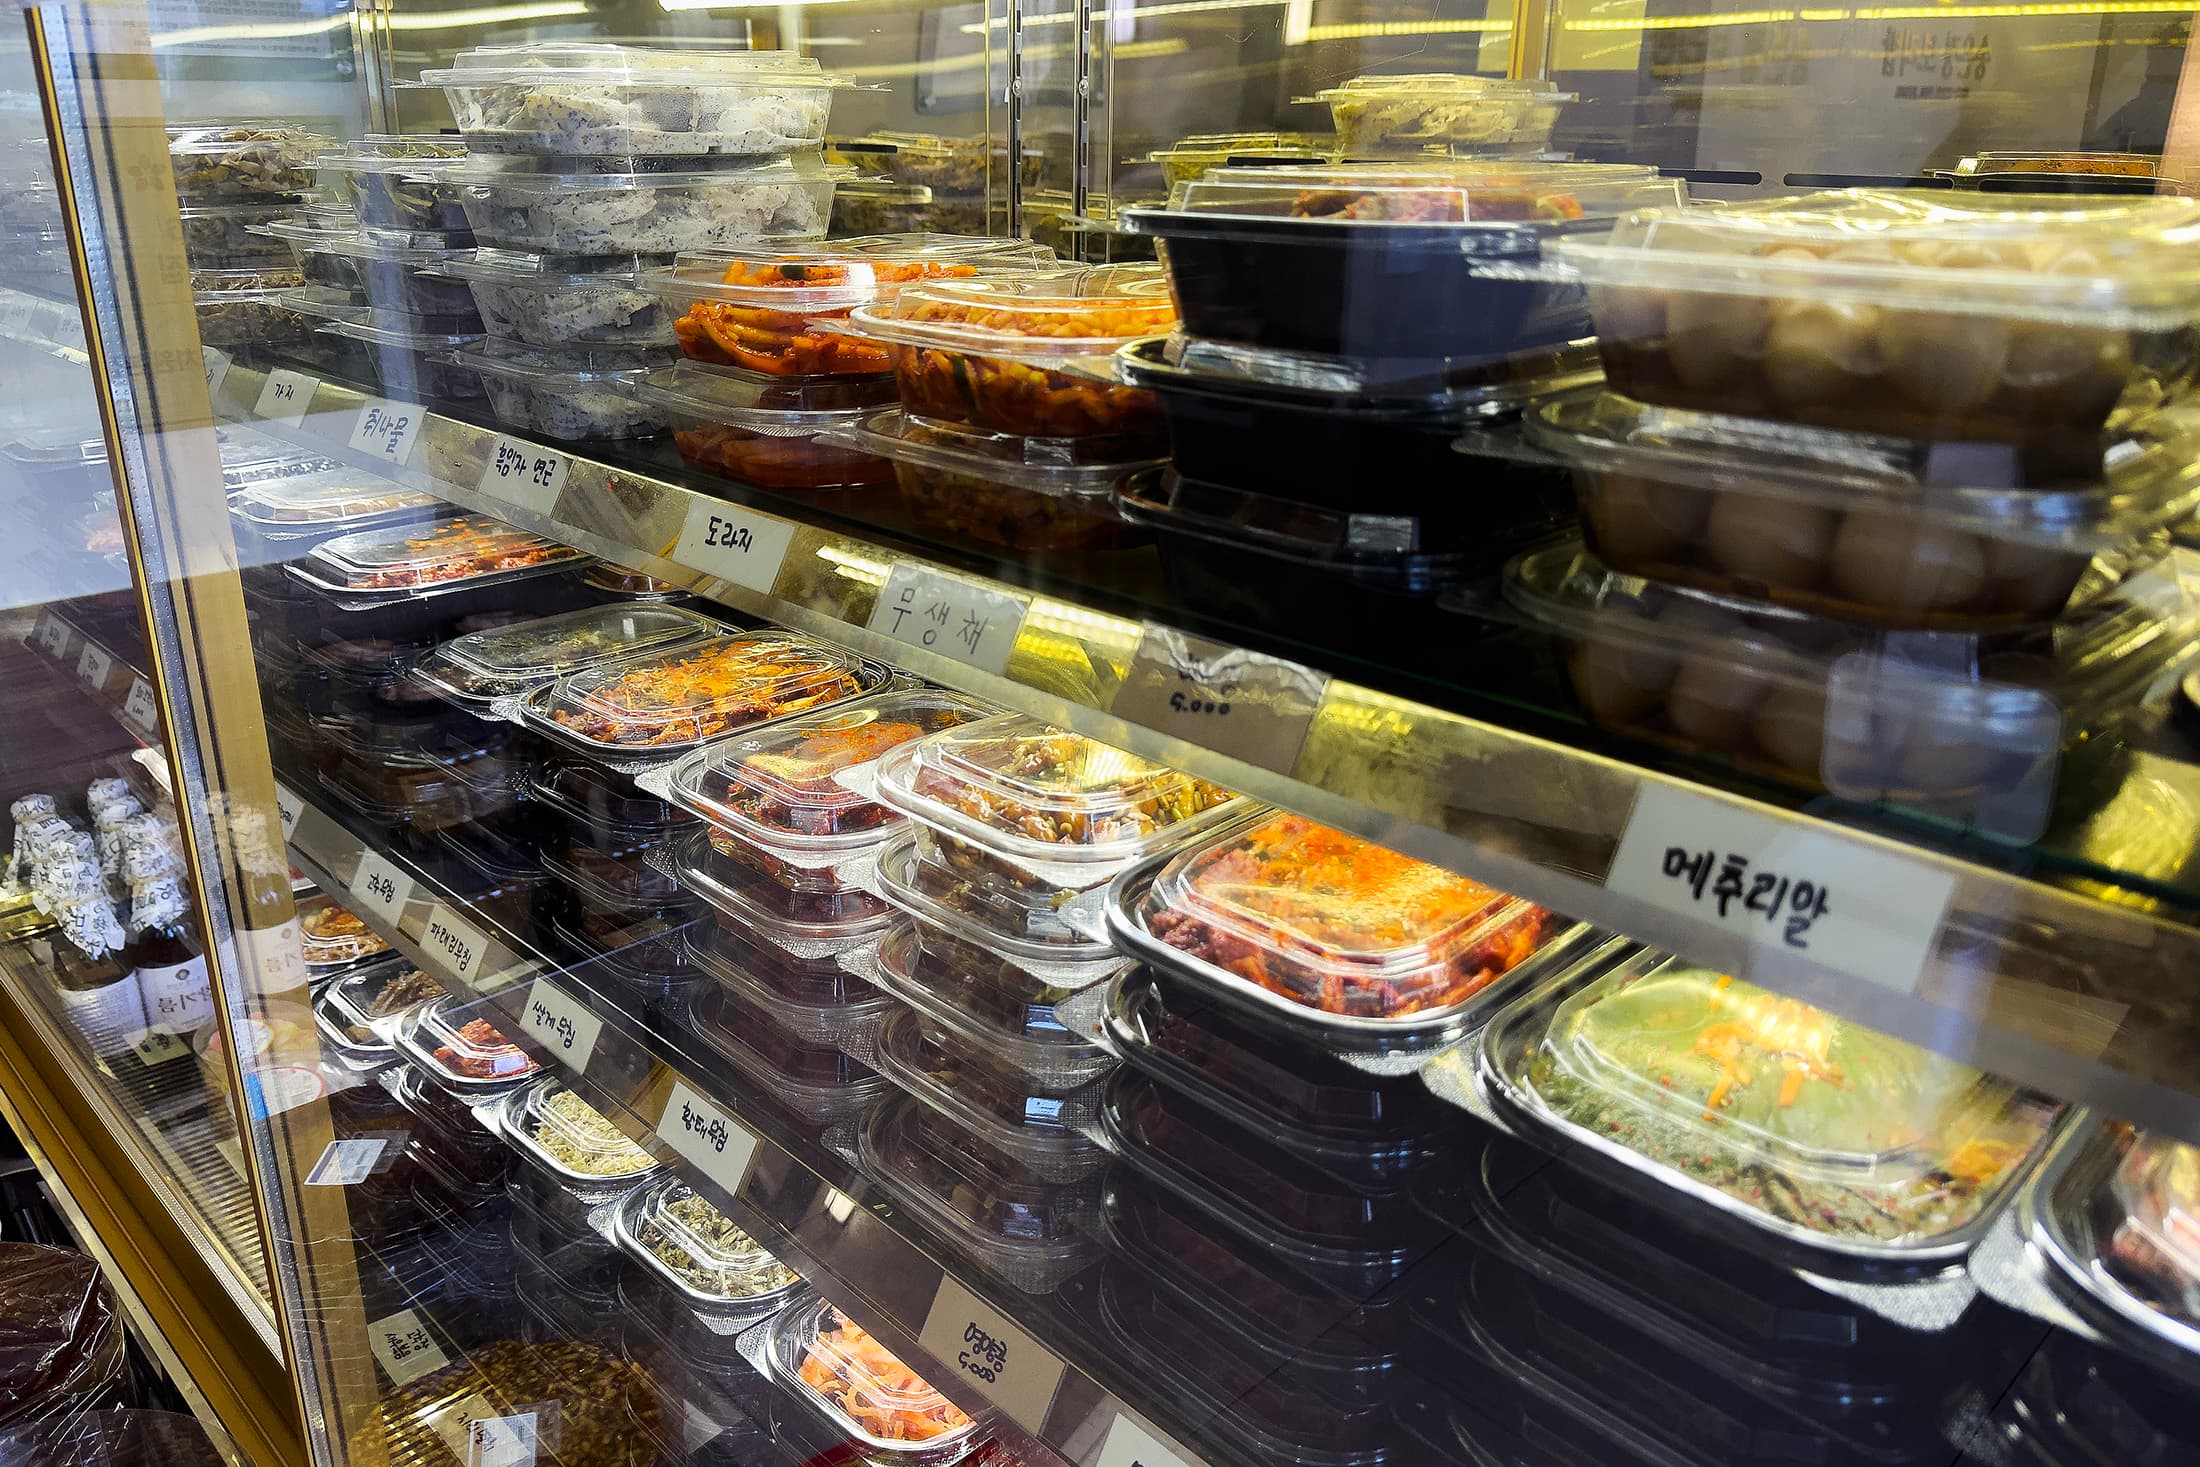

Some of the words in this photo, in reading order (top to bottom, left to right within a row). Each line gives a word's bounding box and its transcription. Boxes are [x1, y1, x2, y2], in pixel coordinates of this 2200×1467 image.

[275, 383, 296, 401] 가지
[362, 408, 409, 455] 취나물
[495, 441, 527, 479] 흑임자
[532, 459, 558, 488] 연근
[703, 516, 755, 554] 도라지
[1662, 846, 1831, 949] 메추리알
